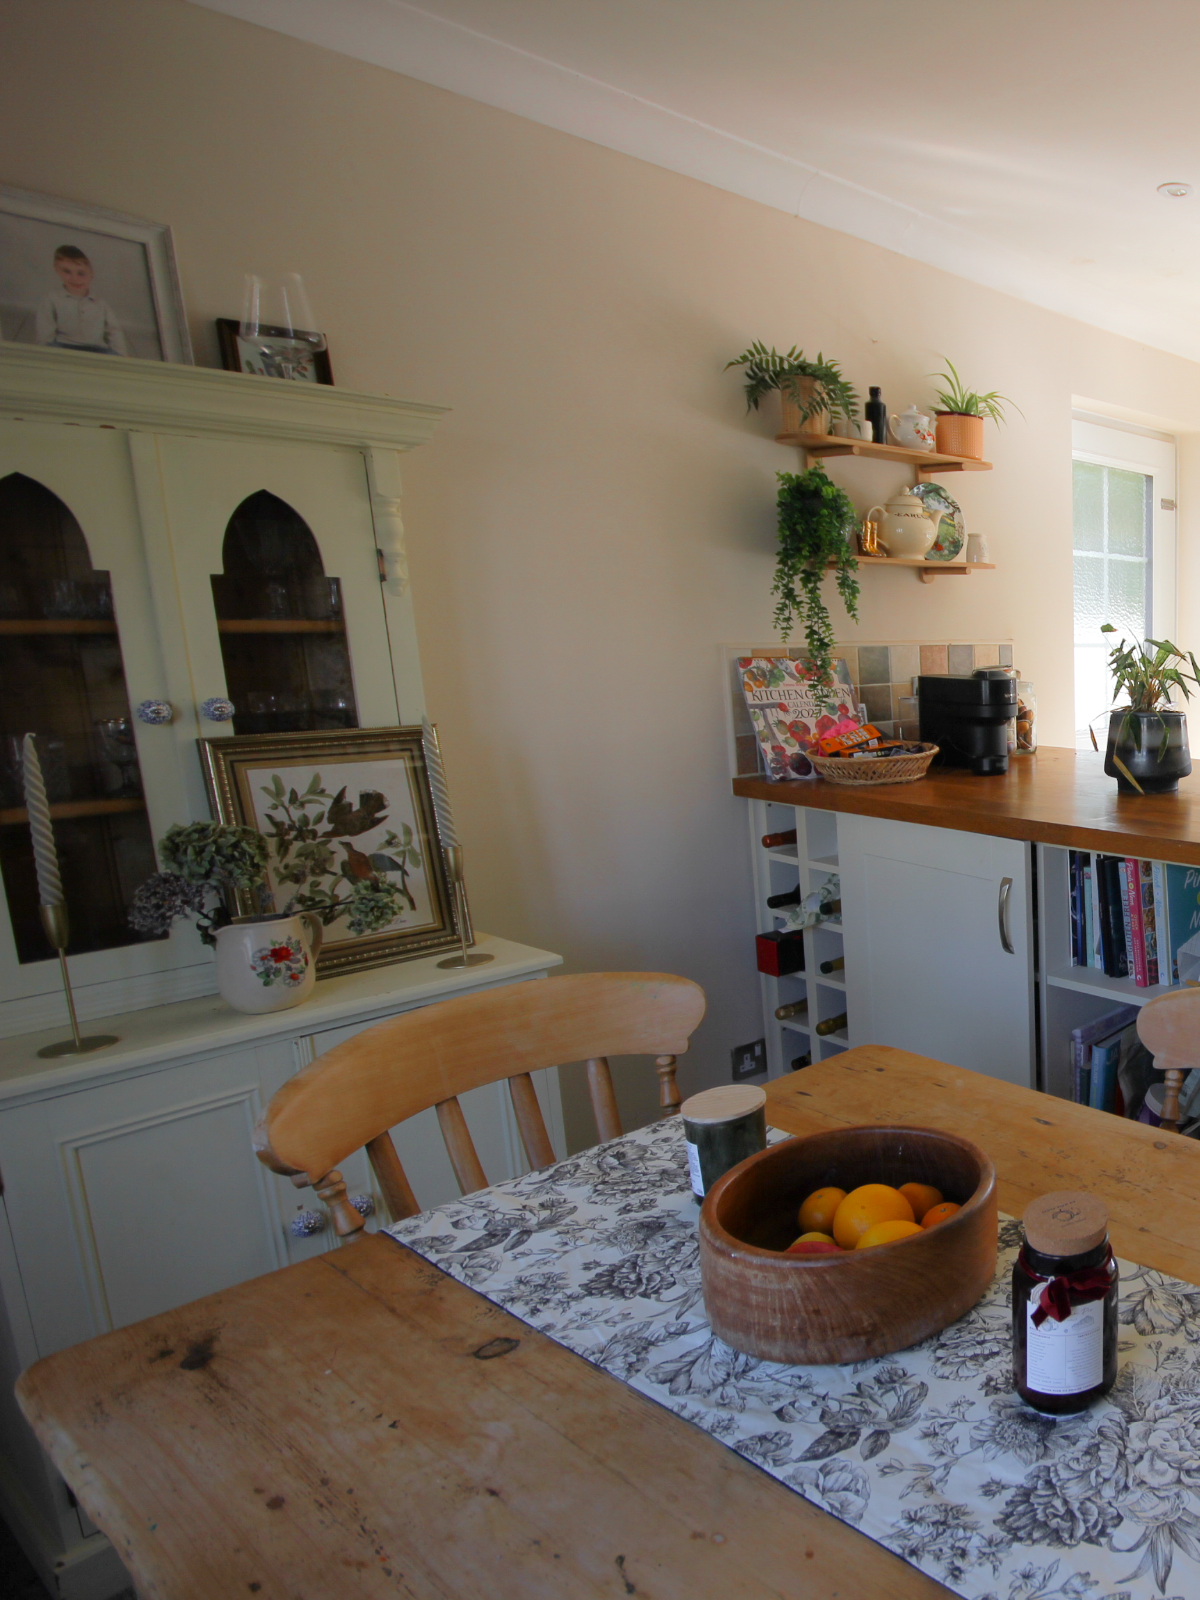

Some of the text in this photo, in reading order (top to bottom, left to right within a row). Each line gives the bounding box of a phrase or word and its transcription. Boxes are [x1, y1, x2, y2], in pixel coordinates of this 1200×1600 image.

[751, 689, 805, 702] KITCHEN
[1126, 861, 1134, 883] Pinch
[1128, 889, 1136, 906] Nom
